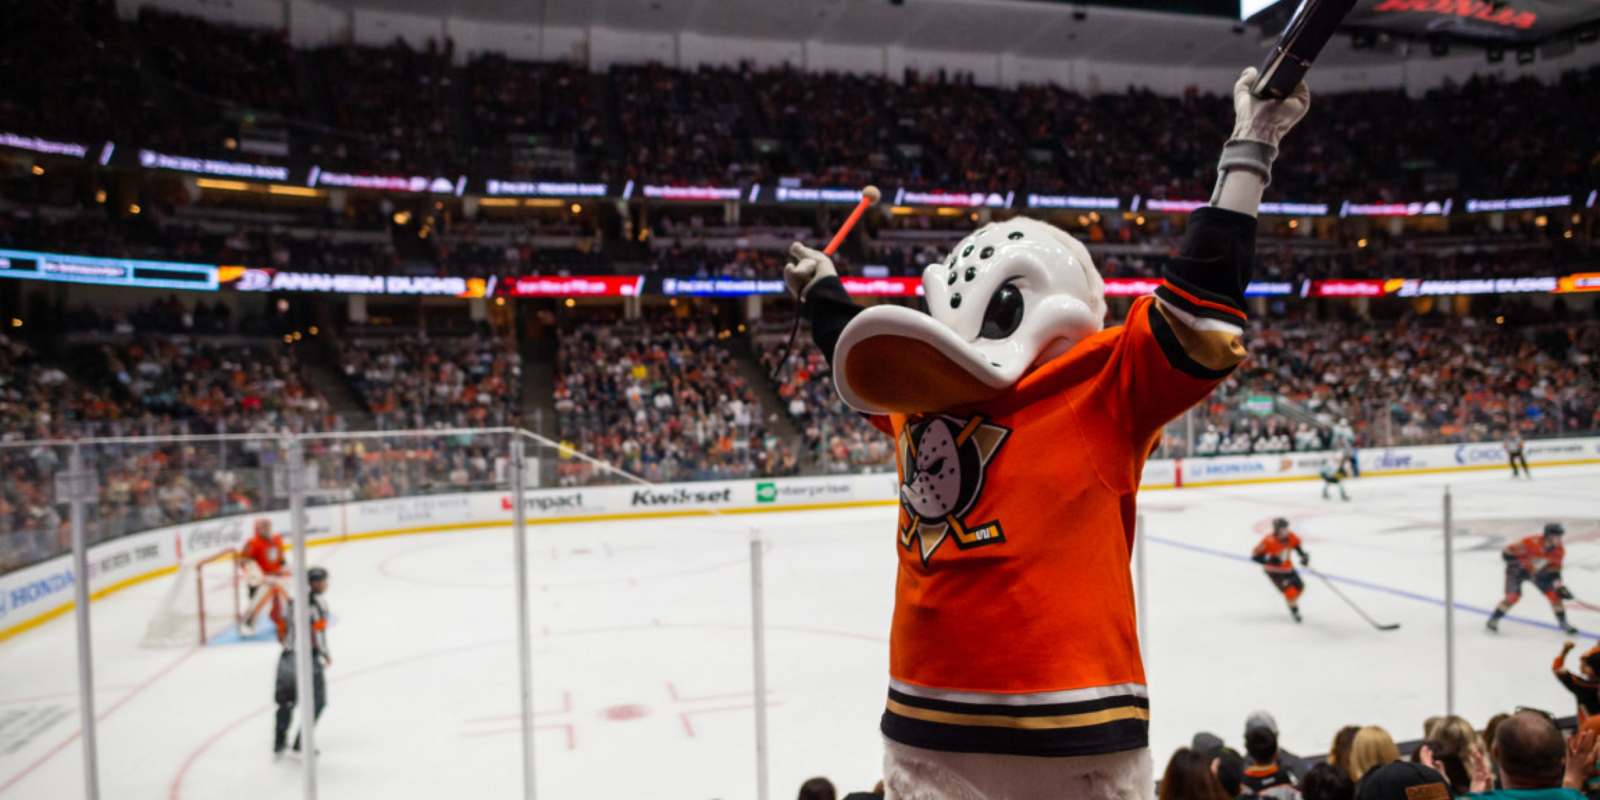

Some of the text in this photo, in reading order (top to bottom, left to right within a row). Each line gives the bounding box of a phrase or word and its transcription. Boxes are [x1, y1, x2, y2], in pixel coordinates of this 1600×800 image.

[1373, 0, 1537, 29] HONDA
[273, 272, 466, 295] ANAHEIM DUCKS
[631, 487, 731, 507] Kwikset
[10, 569, 77, 610] HONDA
